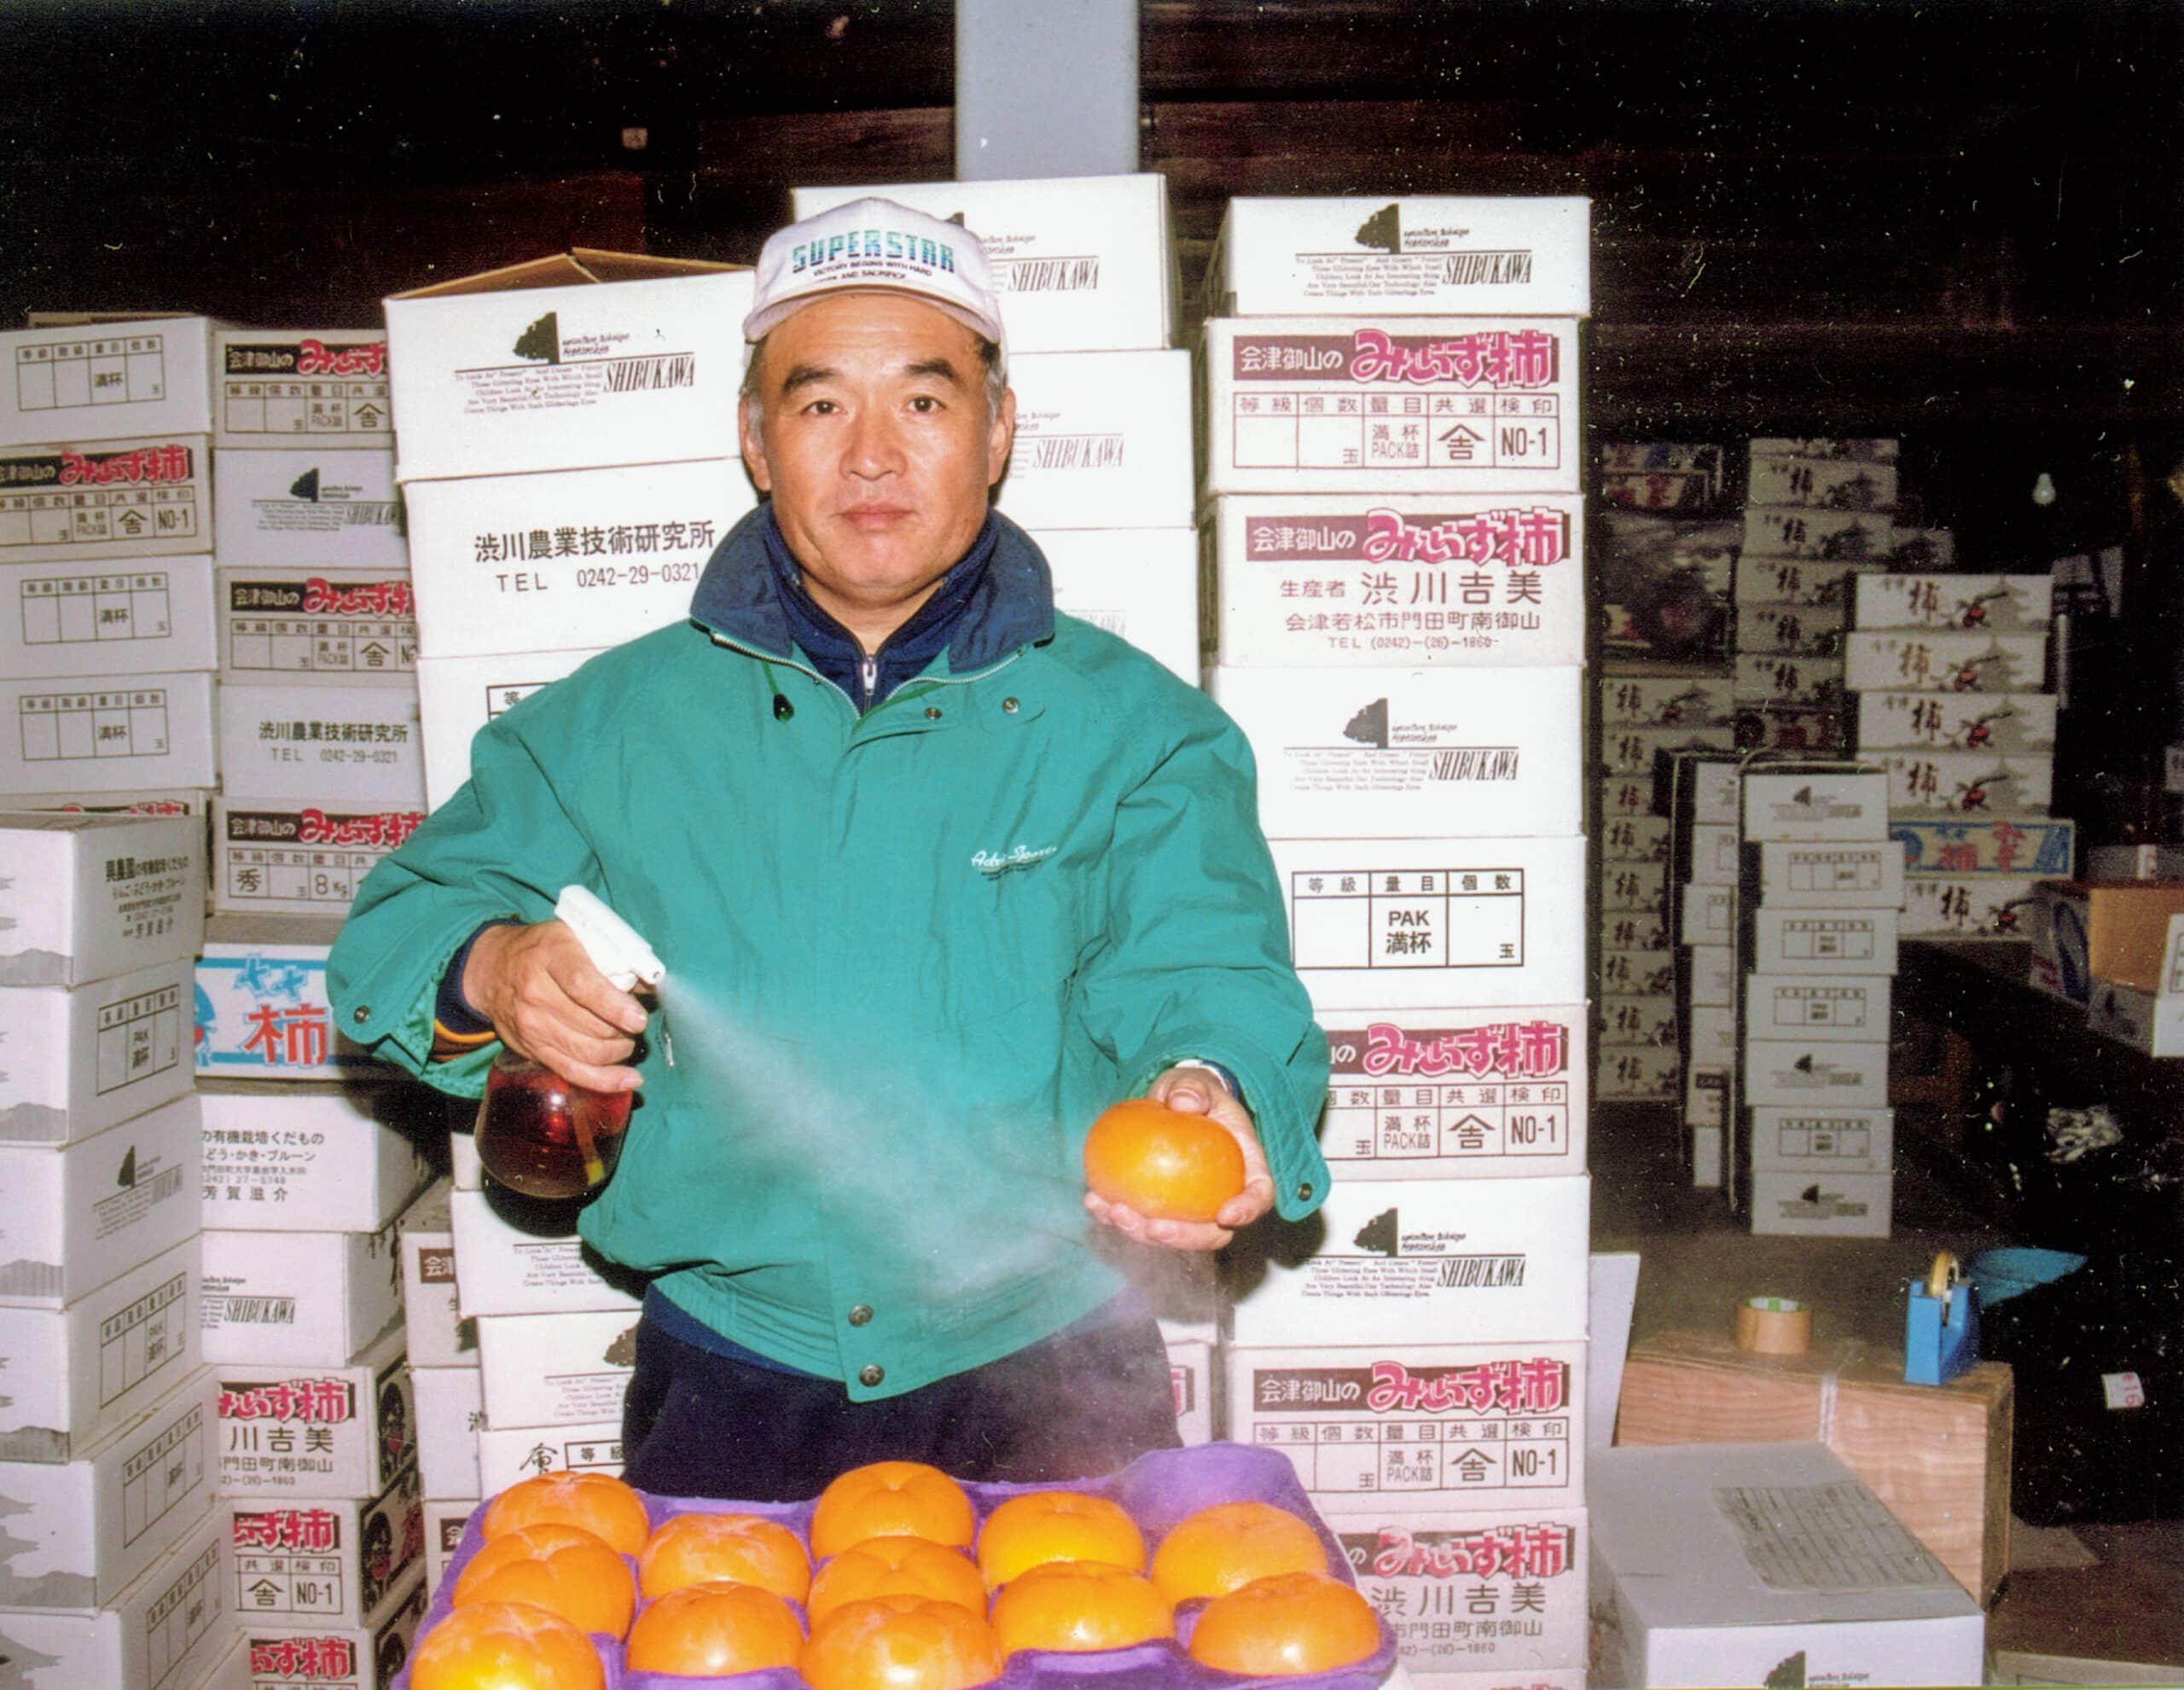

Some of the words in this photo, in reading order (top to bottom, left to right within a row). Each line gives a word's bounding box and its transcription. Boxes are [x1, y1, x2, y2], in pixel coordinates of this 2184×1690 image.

[792, 229, 955, 274] SUPERSTAR
[814, 264, 847, 277] VICTORY
[886, 261, 909, 270] WITH
[909, 265, 932, 276] HARD
[1008, 258, 1099, 292] SHIBUKAWA
[1443, 254, 1532, 285] SHIBUKAWA
[1240, 346, 1344, 373] 会津御山の
[603, 356, 694, 392] SHIBUKAWA
[1240, 396, 1292, 414] 等級
[1303, 396, 1358, 414] 個数
[1370, 396, 1423, 414] 量目
[1434, 396, 1486, 414] 共選
[1501, 395, 1553, 414] 検印
[1372, 423, 1420, 441] 満杯
[1501, 427, 1549, 457] NO-1
[1033, 438, 1125, 469] SHIBUKAWA
[157, 508, 189, 530] NO-1
[474, 520, 716, 564] 渋川農業技術研究所
[1252, 526, 1356, 553] 会津御山の
[496, 572, 549, 593] TEL
[577, 563, 700, 589] 0242-29-0321
[1281, 579, 1346, 599] 生産者
[1360, 570, 1544, 606] 渋川吉美
[1286, 612, 1542, 632] 会津若松市門田町南御山
[1328, 637, 1362, 649] TEL
[258, 721, 409, 743] 渋川農業技術研究所
[270, 747, 304, 762] TEL
[320, 747, 398, 764] 0242-29-0321
[1429, 751, 1519, 781] SHIBUKAWA
[235, 868, 262, 893] 秀
[1308, 877, 1357, 893] 等級
[1385, 875, 1435, 892] 量目
[1461, 874, 1513, 891] 個数
[1388, 909, 1431, 927] PAK
[1385, 931, 1432, 955] 満杯
[1499, 943, 1515, 960] 玉
[244, 1003, 328, 1066] 柿
[1383, 1089, 1434, 1106] 量目
[1447, 1088, 1497, 1105] 共選
[1510, 1085, 1561, 1103] 検印
[1384, 1116, 1431, 1132] 満杯
[1511, 1115, 1557, 1144] NO-1
[1438, 1258, 1526, 1287] SHIBUKAWA
[224, 1298, 296, 1324] SHIBUKAWA
[1261, 1377, 1361, 1403] 会津御山の
[1260, 1424, 1310, 1442] 等級
[1321, 1423, 1374, 1442] 個数
[1386, 1423, 1437, 1441] 量目
[1450, 1422, 1499, 1439] 共選
[1512, 1420, 1563, 1438] 検印
[1387, 1449, 1434, 1466] 満杯
[1512, 1449, 1558, 1478] NO-1
[296, 1582, 333, 1605] NO-1
